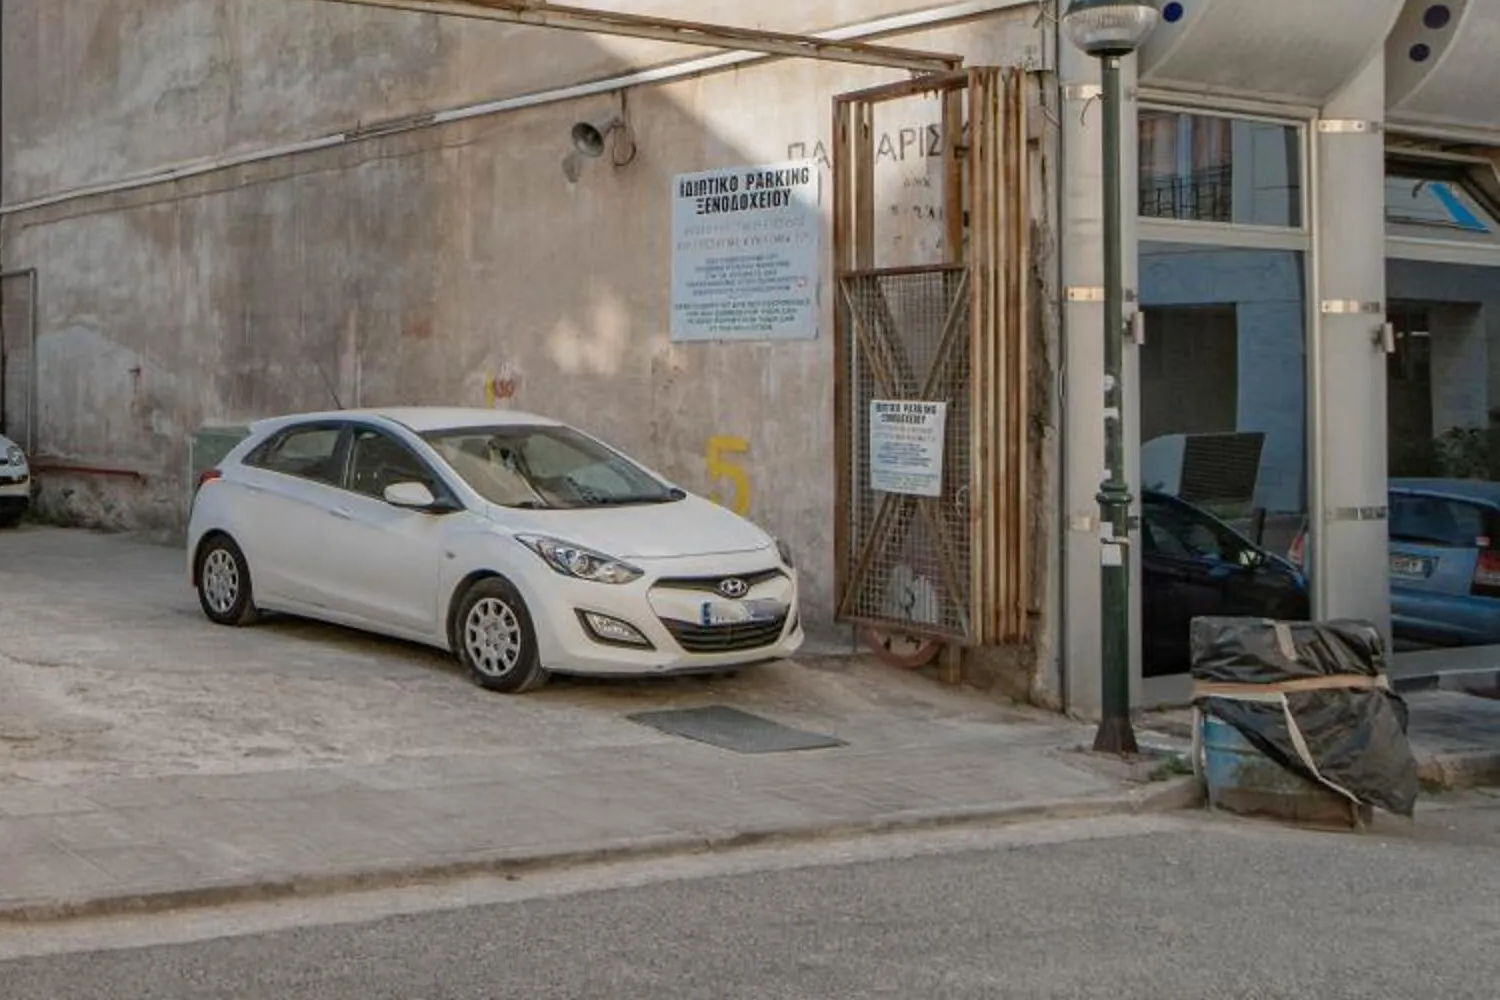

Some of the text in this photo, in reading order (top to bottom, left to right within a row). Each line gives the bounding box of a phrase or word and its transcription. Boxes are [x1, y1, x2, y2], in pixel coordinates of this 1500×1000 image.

[746, 167, 810, 190] PARKING
[696, 188, 792, 215] ΞΕΝΟΔΟΧΕΙΟΥ
[704, 433, 751, 517] 5
